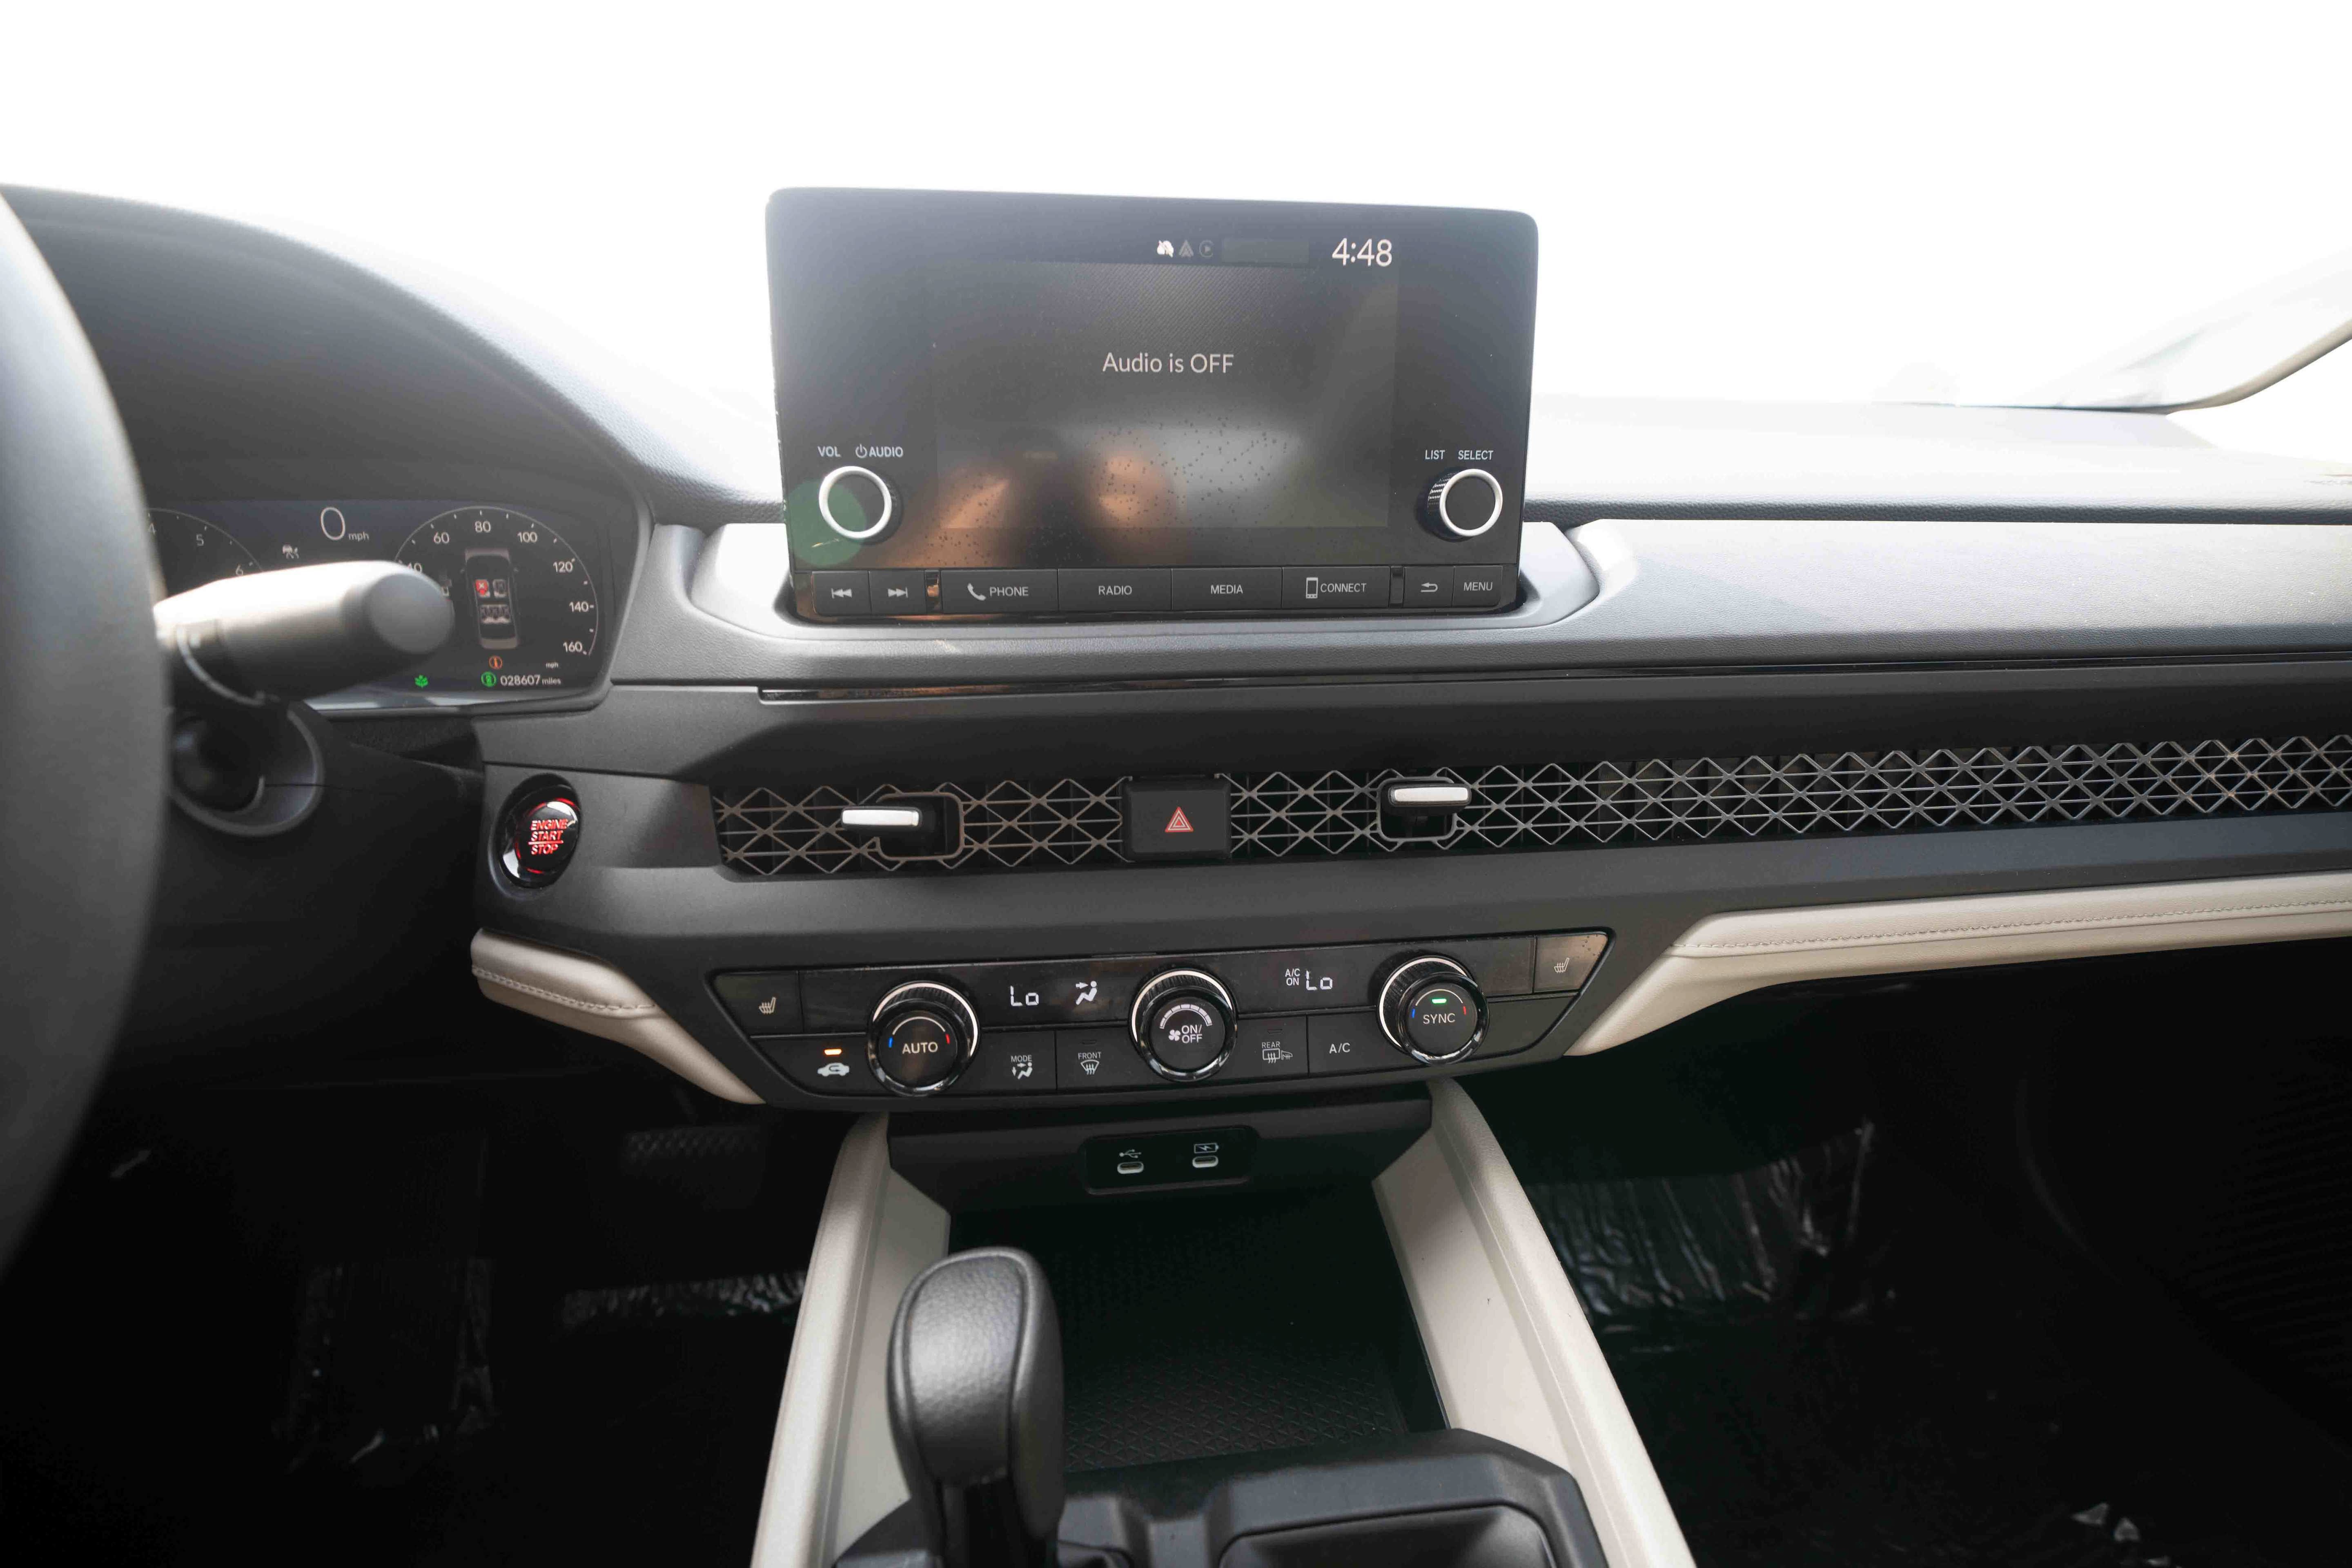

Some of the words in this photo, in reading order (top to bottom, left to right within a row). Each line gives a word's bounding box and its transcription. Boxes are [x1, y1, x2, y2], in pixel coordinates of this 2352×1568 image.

[1332, 238, 1392, 267] 4:48
[1102, 352, 1162, 372] Audio
[1169, 353, 1184, 373] is
[1190, 353, 1234, 373] OFF
[817, 446, 841, 457] VOL
[869, 446, 903, 457] AUDIO
[1425, 450, 1446, 460] LIST
[1458, 450, 1494, 460] SELECT
[320, 507, 345, 540] 0
[348, 531, 369, 541] mph
[475, 521, 491, 532] 80
[196, 534, 204, 546] 5
[433, 532, 450, 543] 60
[517, 532, 537, 543] 100
[235, 564, 244, 576] 6
[553, 561, 572, 572] 120
[989, 586, 1029, 597] PHONE
[1098, 585, 1132, 595] RADIO
[1211, 584, 1243, 594] MEDIA
[1320, 583, 1367, 592] CONNECT
[1463, 582, 1493, 591] MENU
[569, 601, 589, 612] 140
[563, 641, 583, 652] 160
[500, 675, 540, 686] 028607
[530, 819, 568, 831] ENGINE
[531, 830, 564, 841] START
[531, 844, 558, 855] STOP
[1285, 968, 1300, 977] A/C
[1286, 977, 1299, 986] ON
[1305, 970, 1333, 991] Lo
[1010, 985, 1039, 1007] Lo
[1423, 1013, 1455, 1024] SYNC
[1181, 1024, 1202, 1034] ON/
[1182, 1033, 1203, 1044] OFF
[902, 1042, 938, 1054] AUTO
[1329, 1042, 1350, 1054] A/C
